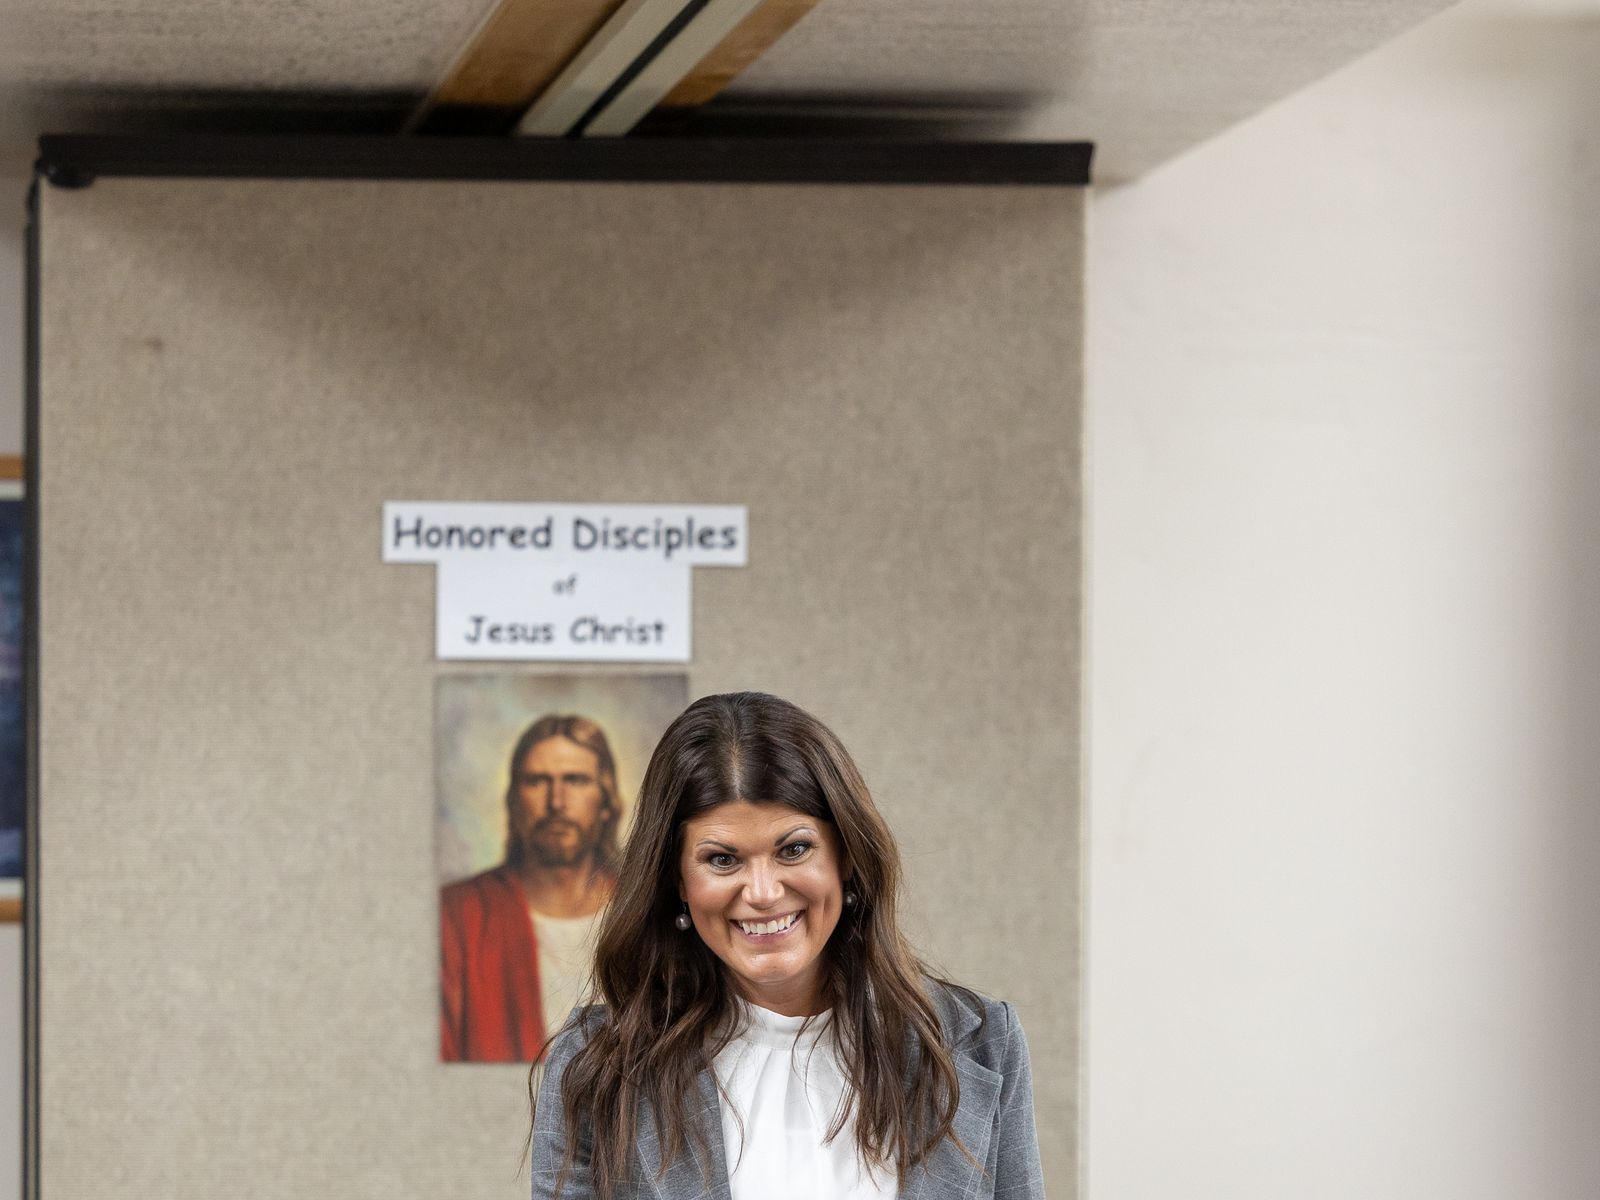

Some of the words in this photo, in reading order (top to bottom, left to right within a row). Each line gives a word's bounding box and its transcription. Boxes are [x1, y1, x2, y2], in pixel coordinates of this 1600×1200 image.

[393, 516, 553, 550] Honored
[573, 517, 737, 558] Disciples
[552, 574, 578, 595] of
[465, 616, 555, 644] Jesus
[569, 616, 665, 644] Christ
